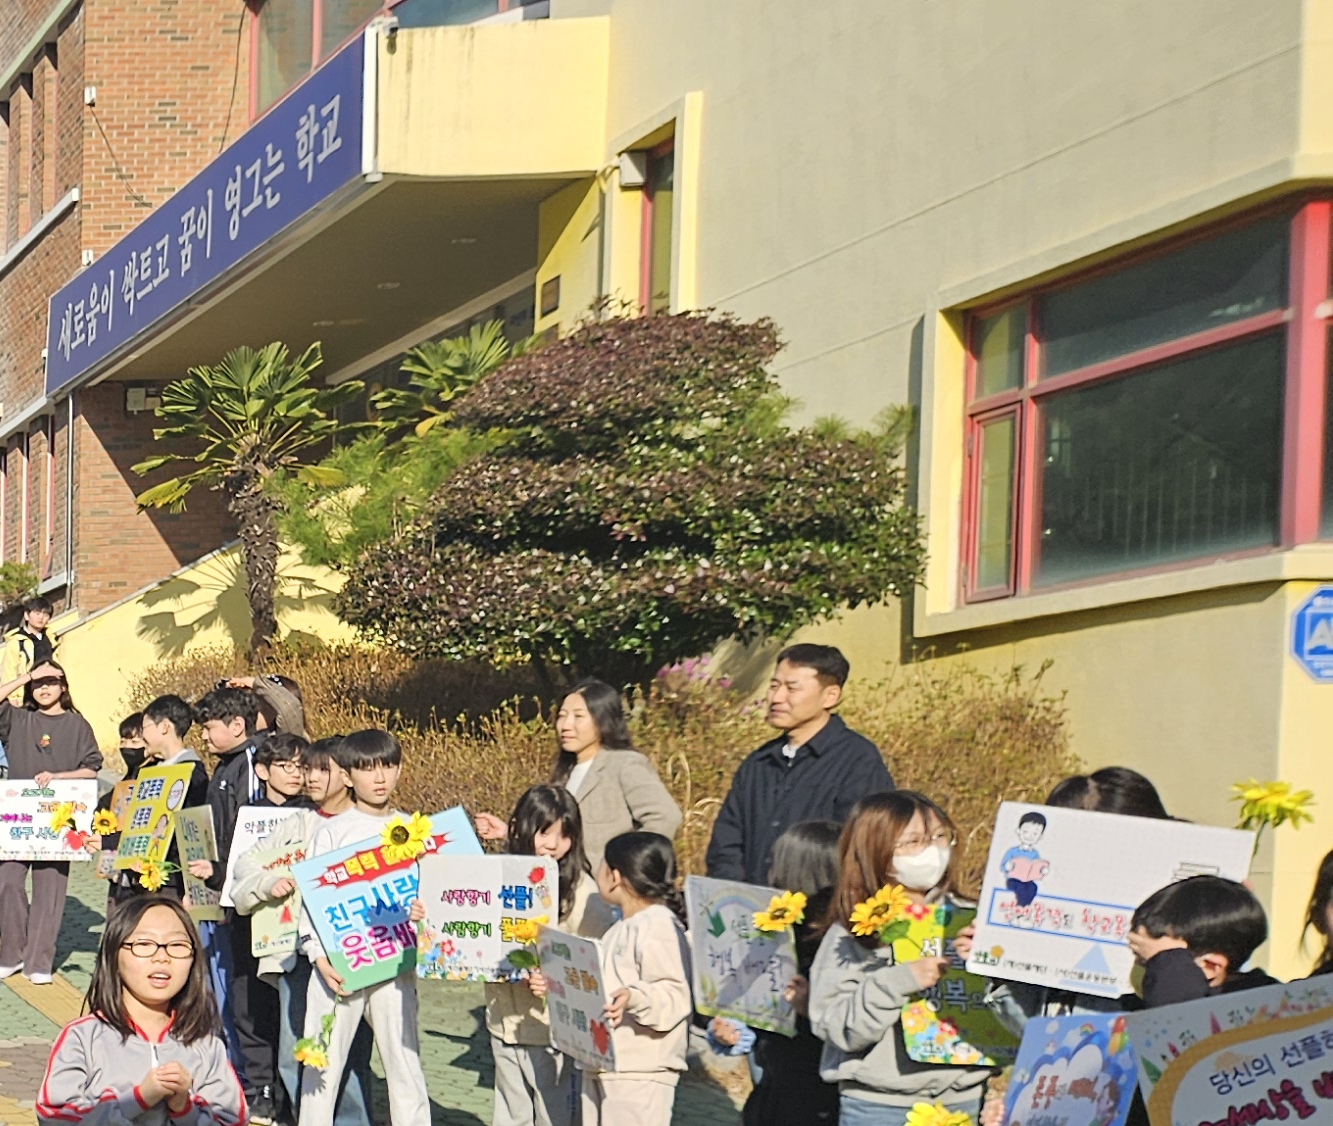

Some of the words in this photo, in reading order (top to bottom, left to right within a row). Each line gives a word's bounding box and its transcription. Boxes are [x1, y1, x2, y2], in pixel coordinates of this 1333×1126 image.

[58, 269, 115, 362] 새로움이
[121, 234, 170, 316] 싹트고
[177, 189, 213, 278] 꿈이
[224, 142, 285, 241] 영그는
[295, 93, 342, 184] 학교
[1082, 908, 1128, 940] 학교폭
[1210, 1054, 1276, 1095] 당신의
